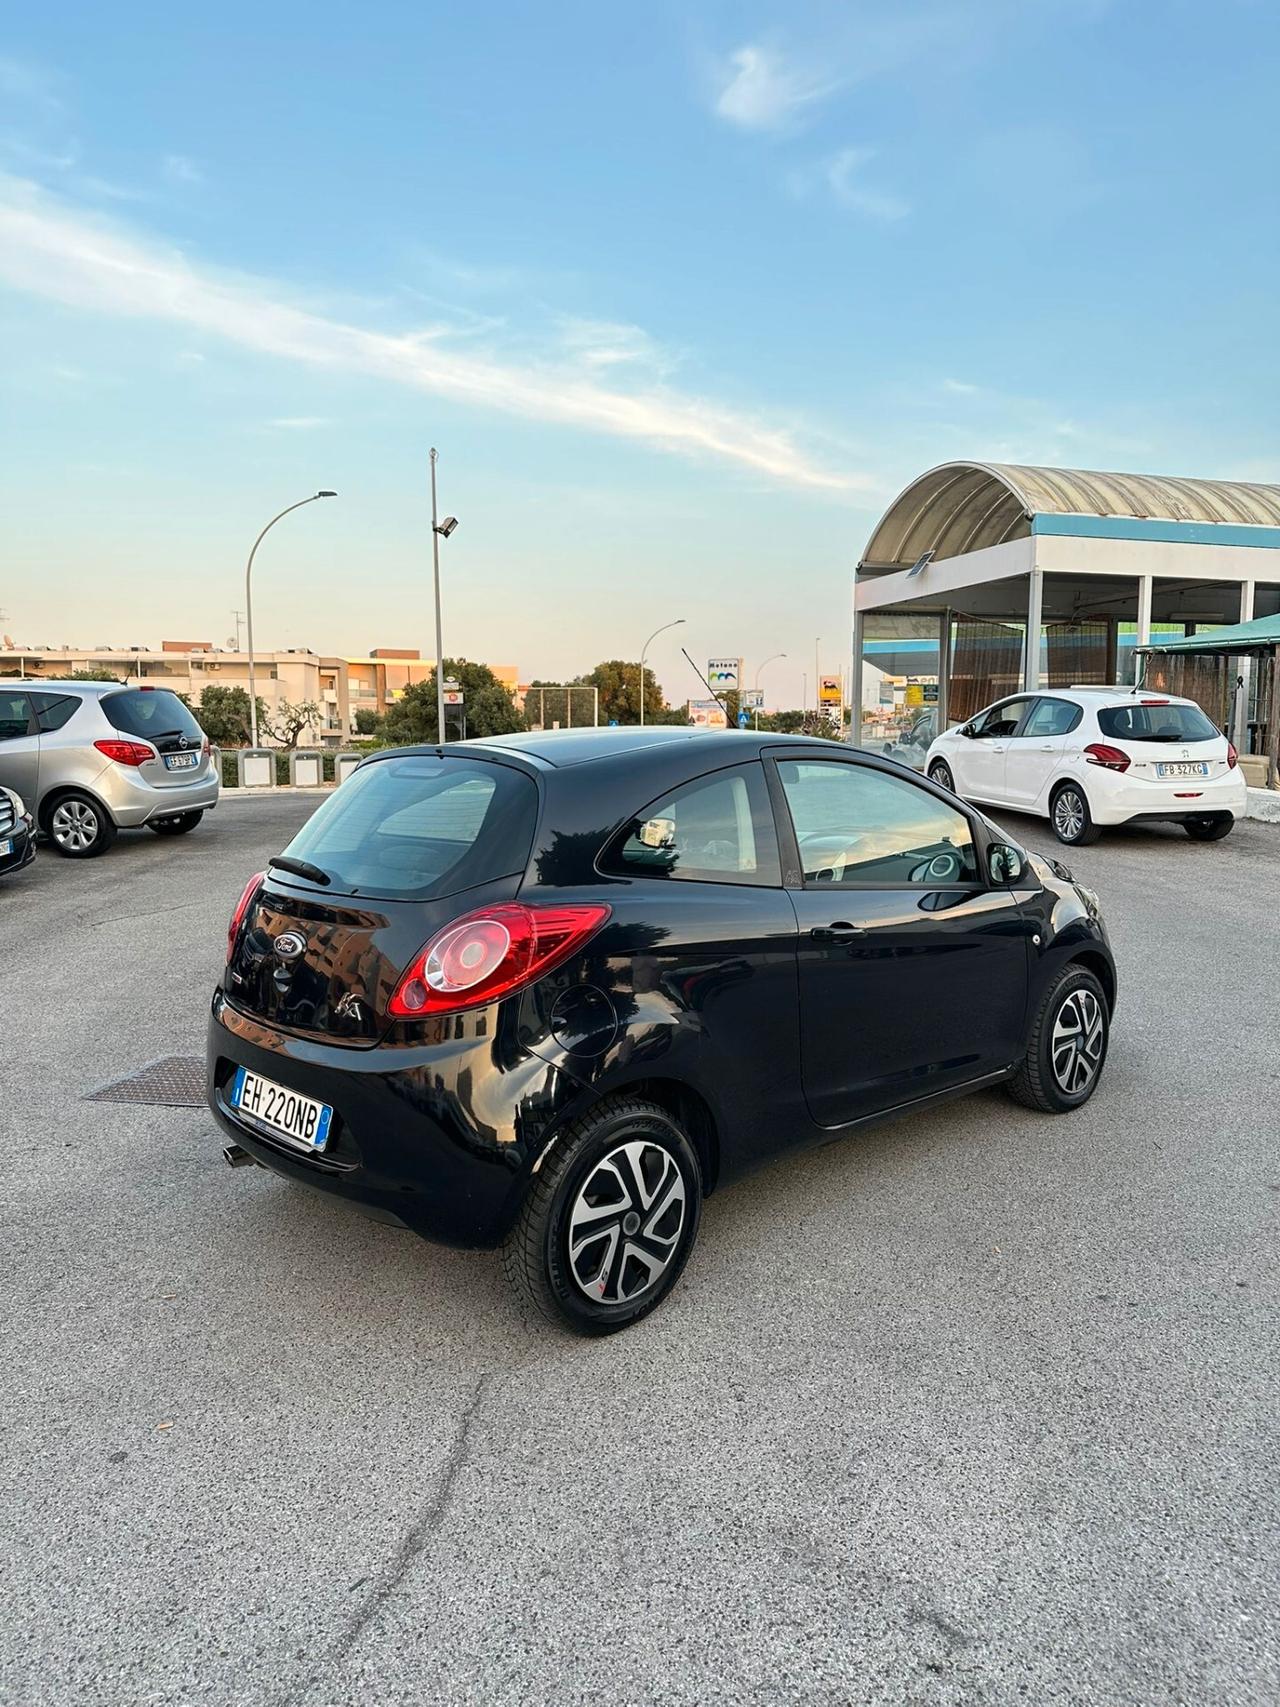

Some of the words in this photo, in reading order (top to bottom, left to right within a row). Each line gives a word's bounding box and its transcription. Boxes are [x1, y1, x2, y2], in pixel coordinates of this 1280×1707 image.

[277, 938, 295, 952] Ford
[242, 1075, 264, 1112] EH
[264, 1087, 318, 1139] 220NB
